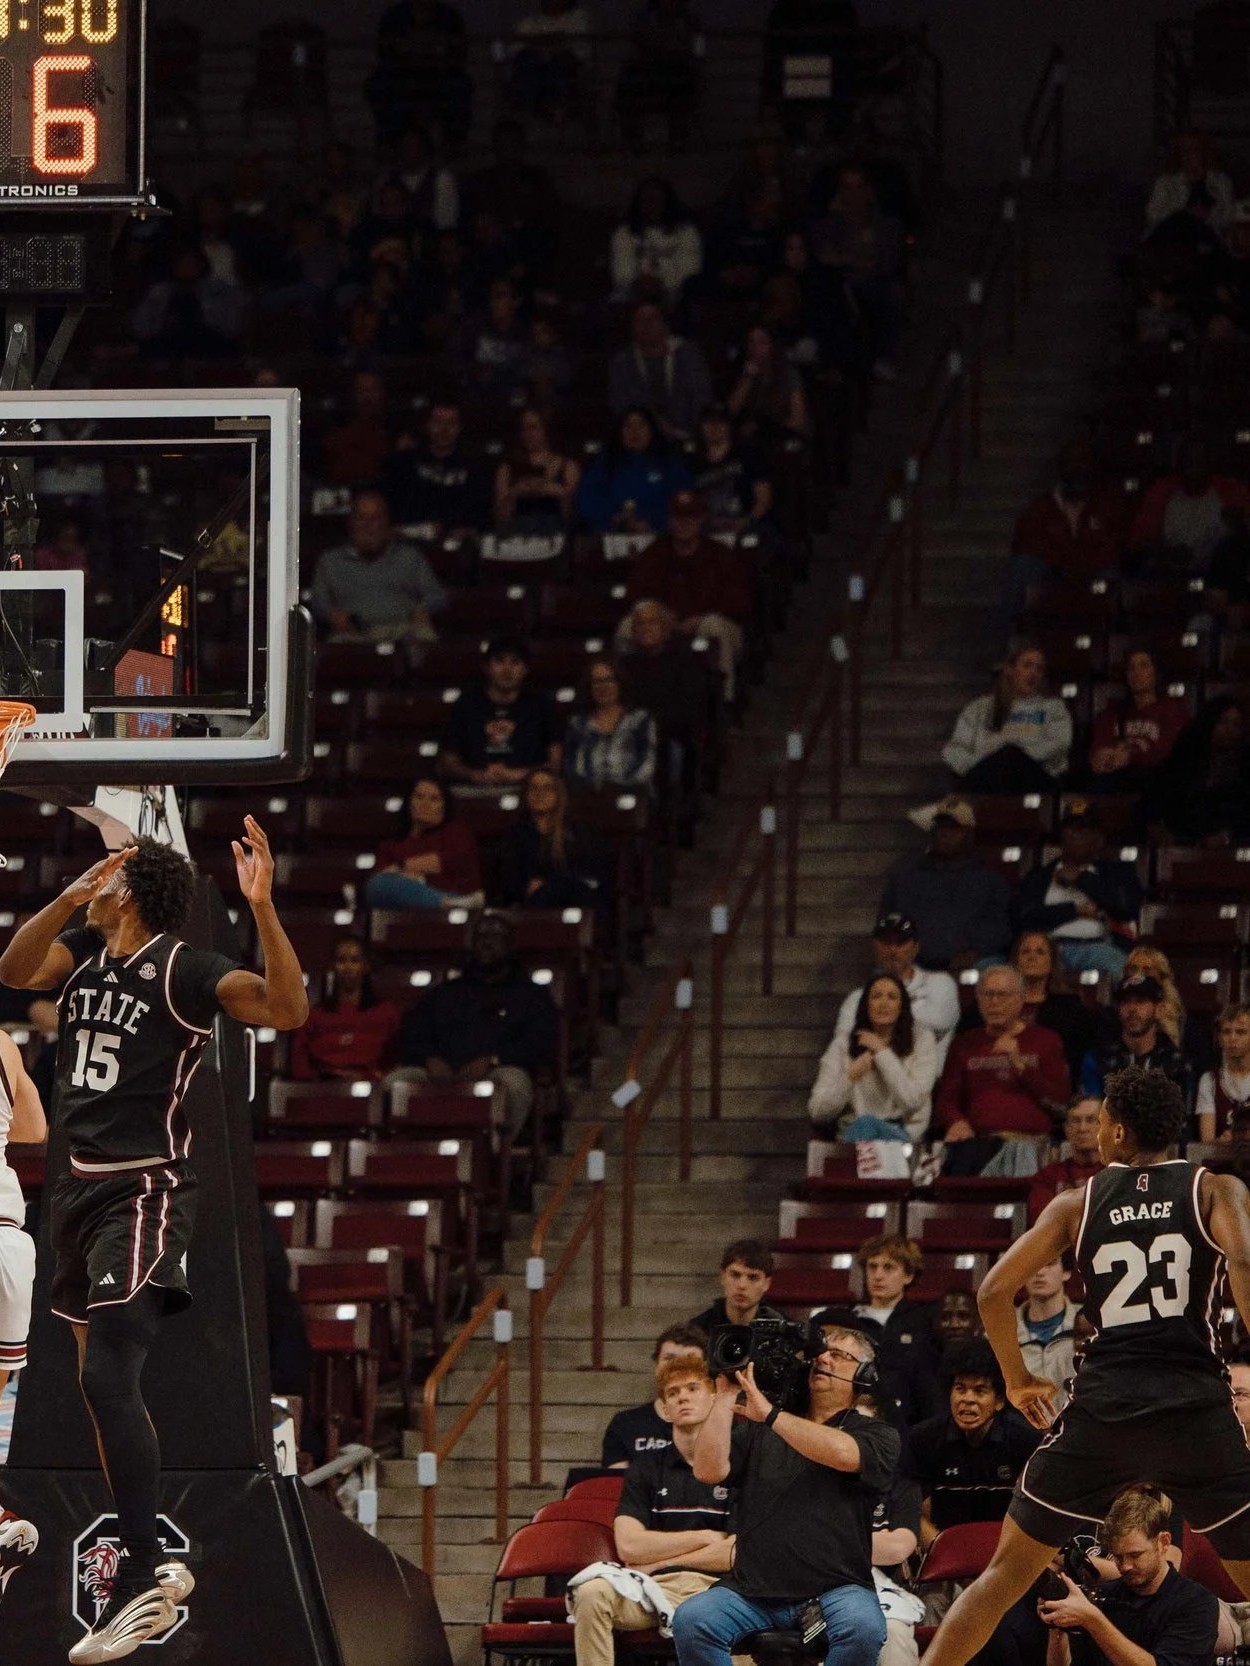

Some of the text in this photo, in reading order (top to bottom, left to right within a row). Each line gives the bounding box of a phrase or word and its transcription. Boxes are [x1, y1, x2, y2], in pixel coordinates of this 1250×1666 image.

[33, 55, 96, 175] 6
[67, 987, 151, 1036] STATE
[71, 1028, 122, 1092] 15
[1108, 1200, 1174, 1226] GRACE
[1091, 1232, 1193, 1329] 23
